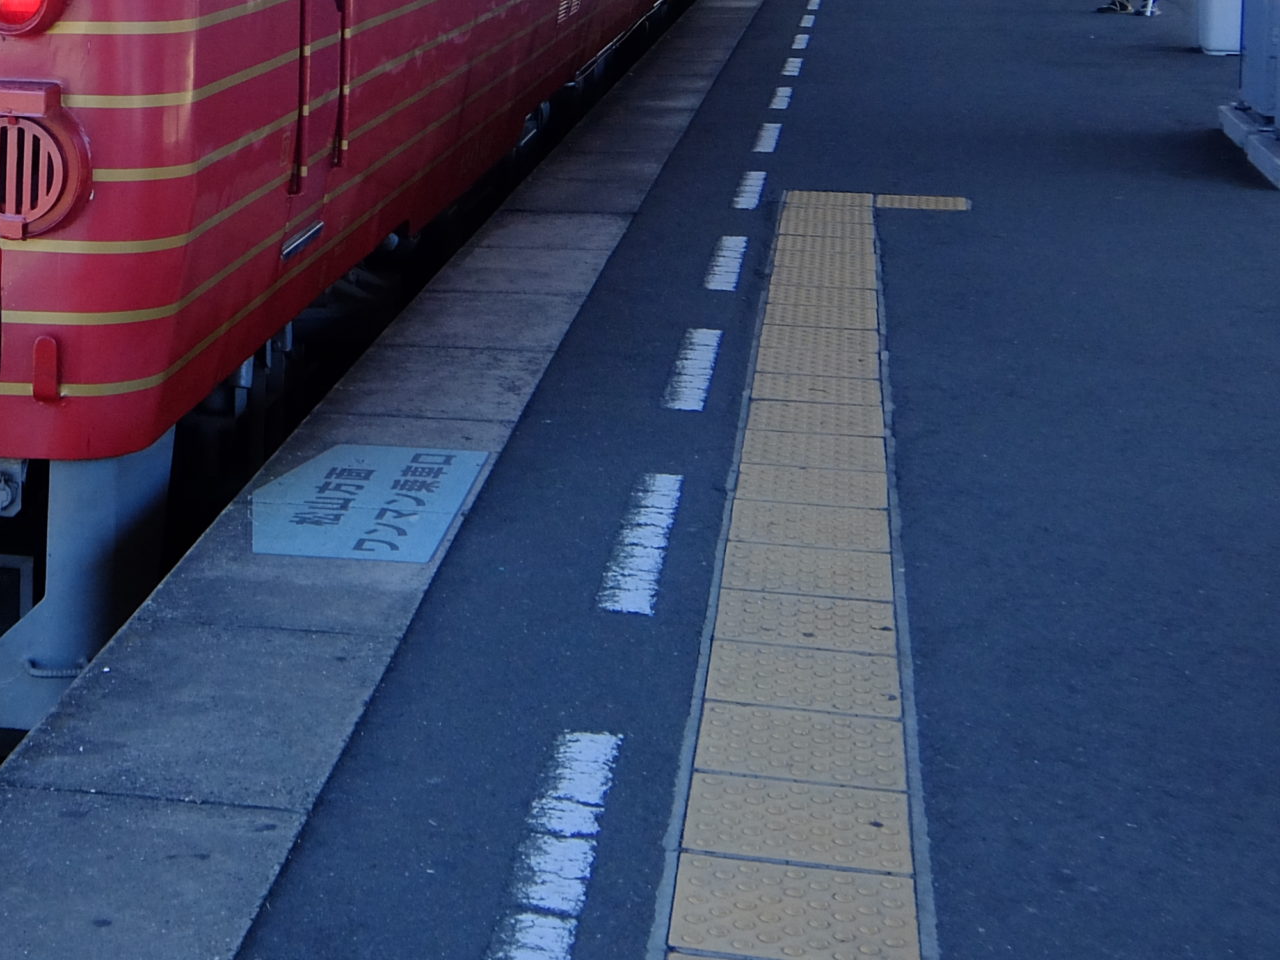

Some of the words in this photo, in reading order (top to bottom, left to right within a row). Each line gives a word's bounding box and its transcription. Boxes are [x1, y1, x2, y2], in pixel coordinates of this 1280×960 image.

[288, 466, 376, 527] 松山方面
[352, 452, 457, 552] ワンマン乗車口
